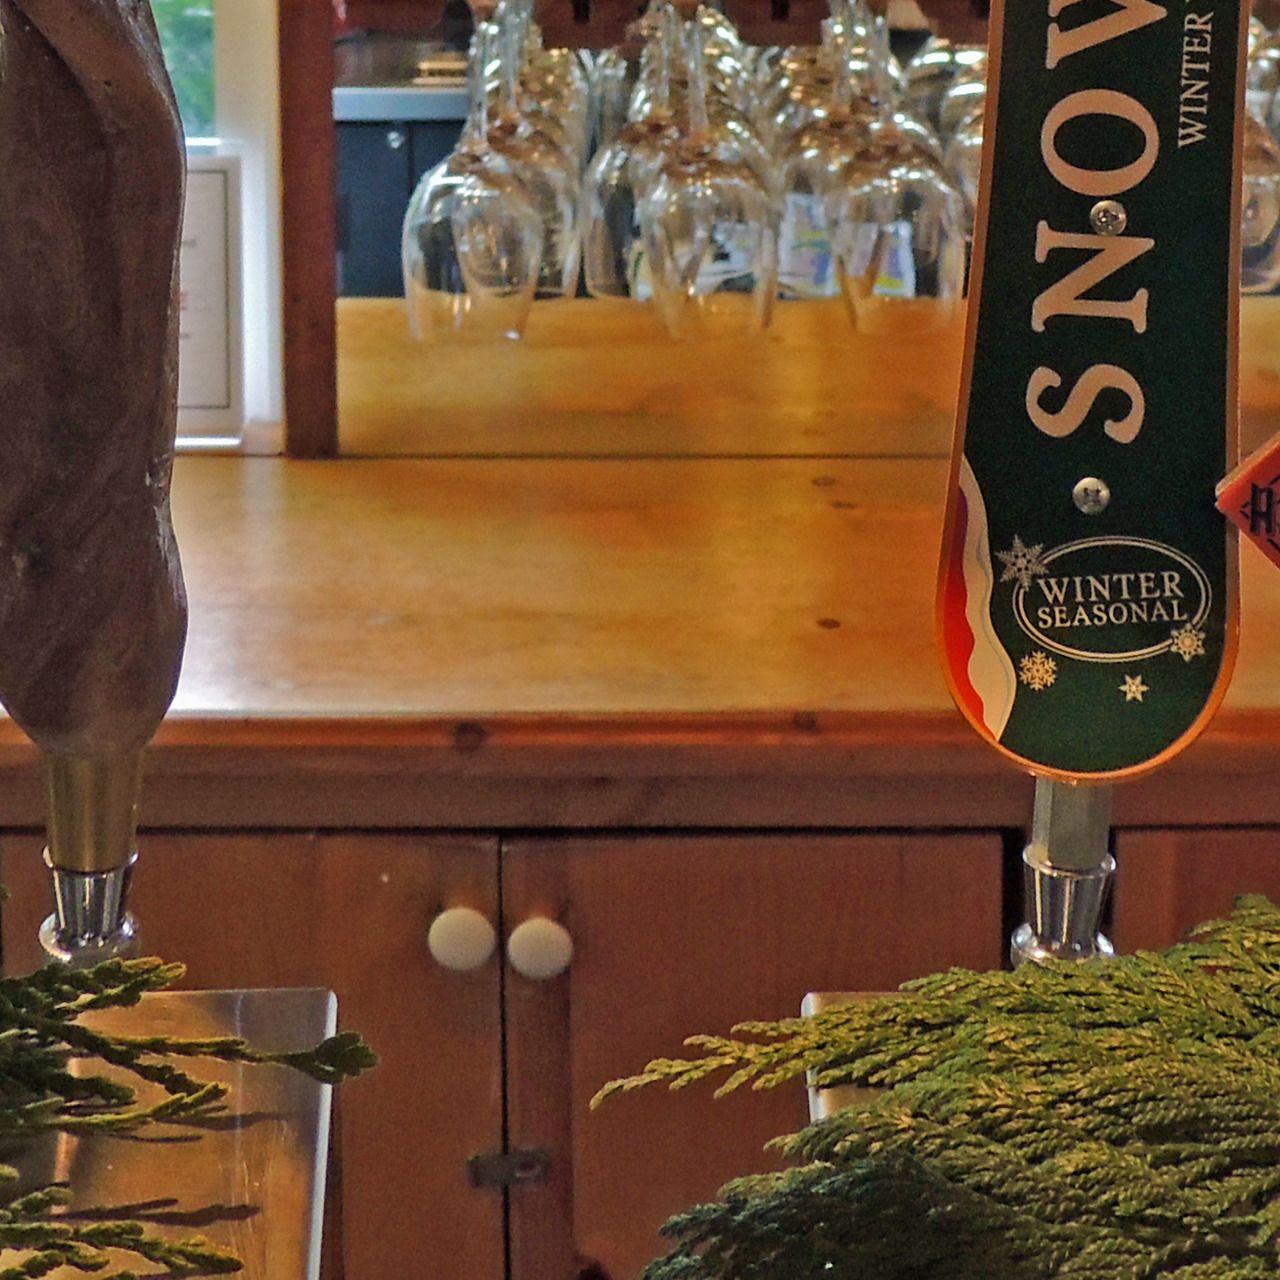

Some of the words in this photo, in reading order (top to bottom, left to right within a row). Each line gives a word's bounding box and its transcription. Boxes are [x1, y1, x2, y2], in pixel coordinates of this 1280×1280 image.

[1177, 10, 1215, 150] WINTER
[1036, 571, 1185, 605] WINTER
[1037, 599, 1188, 630] SEASONAL
